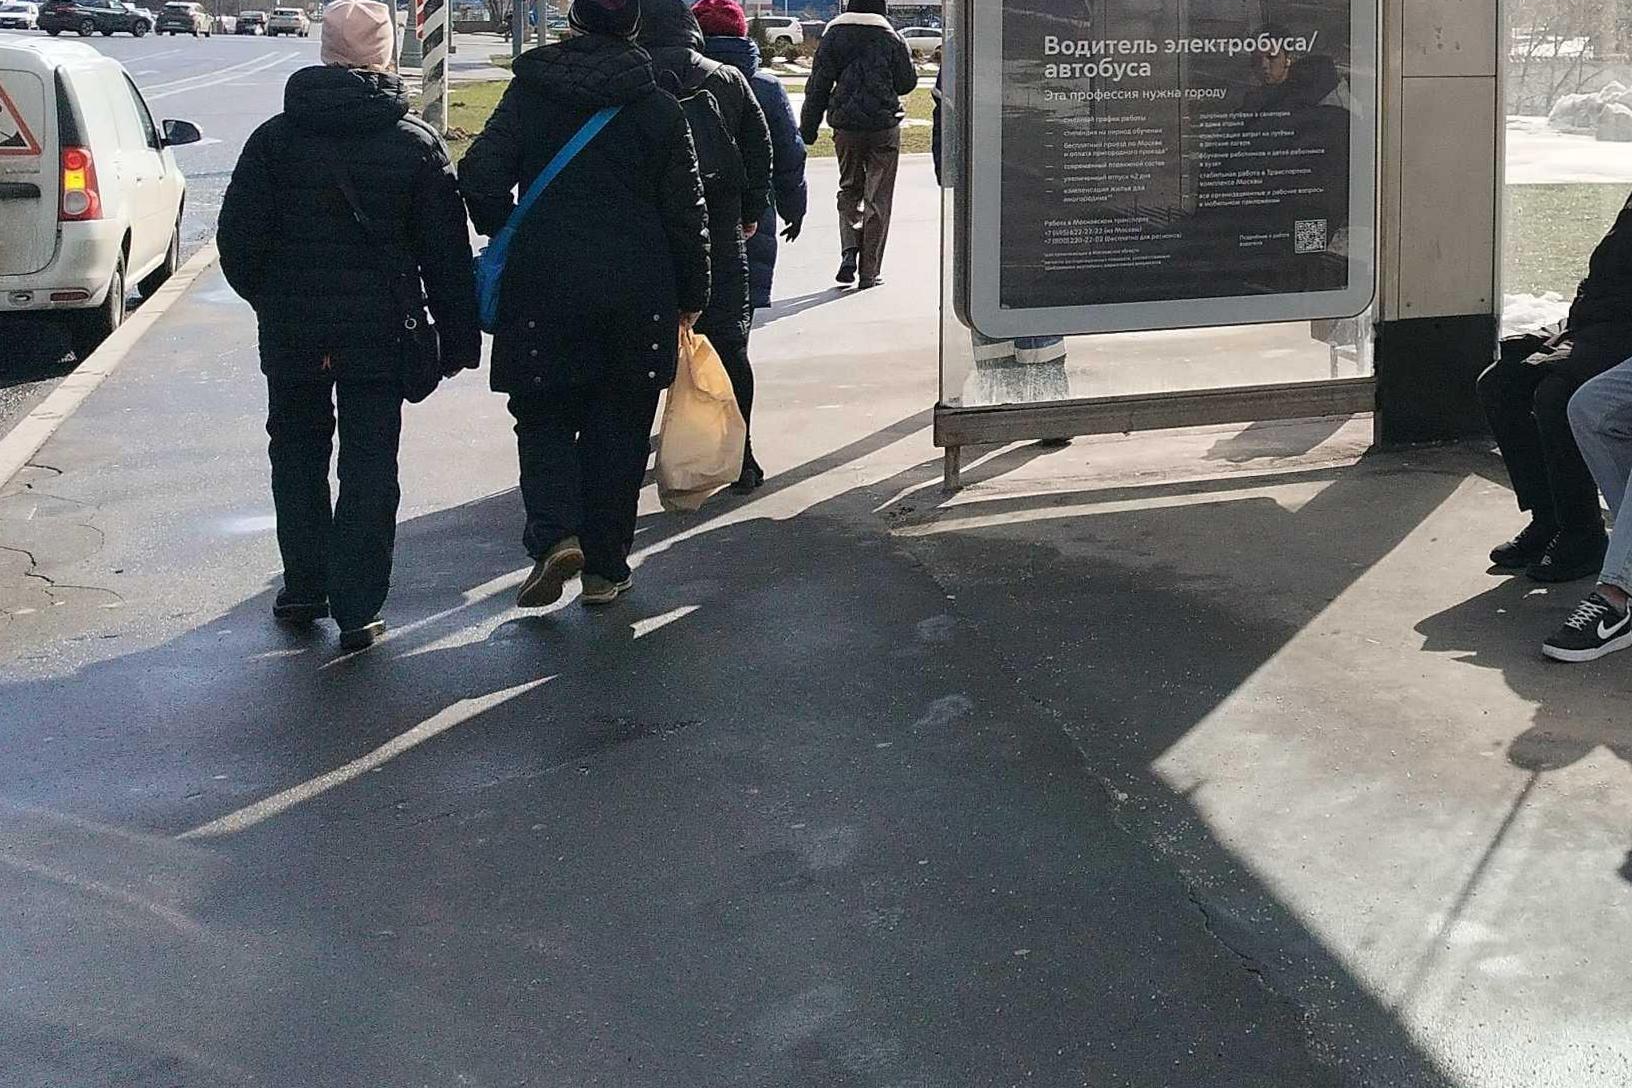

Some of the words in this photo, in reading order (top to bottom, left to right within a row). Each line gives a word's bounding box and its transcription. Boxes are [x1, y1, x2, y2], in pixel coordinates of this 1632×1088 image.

[1044, 36, 1158, 57] Водитель
[1164, 31, 1318, 57] электробуса/
[1044, 58, 1151, 82] автобуса
[1044, 90, 1067, 101] Эта
[1070, 89, 1139, 102] профессия
[1142, 89, 1182, 101] нужна
[1184, 88, 1227, 99] городу
